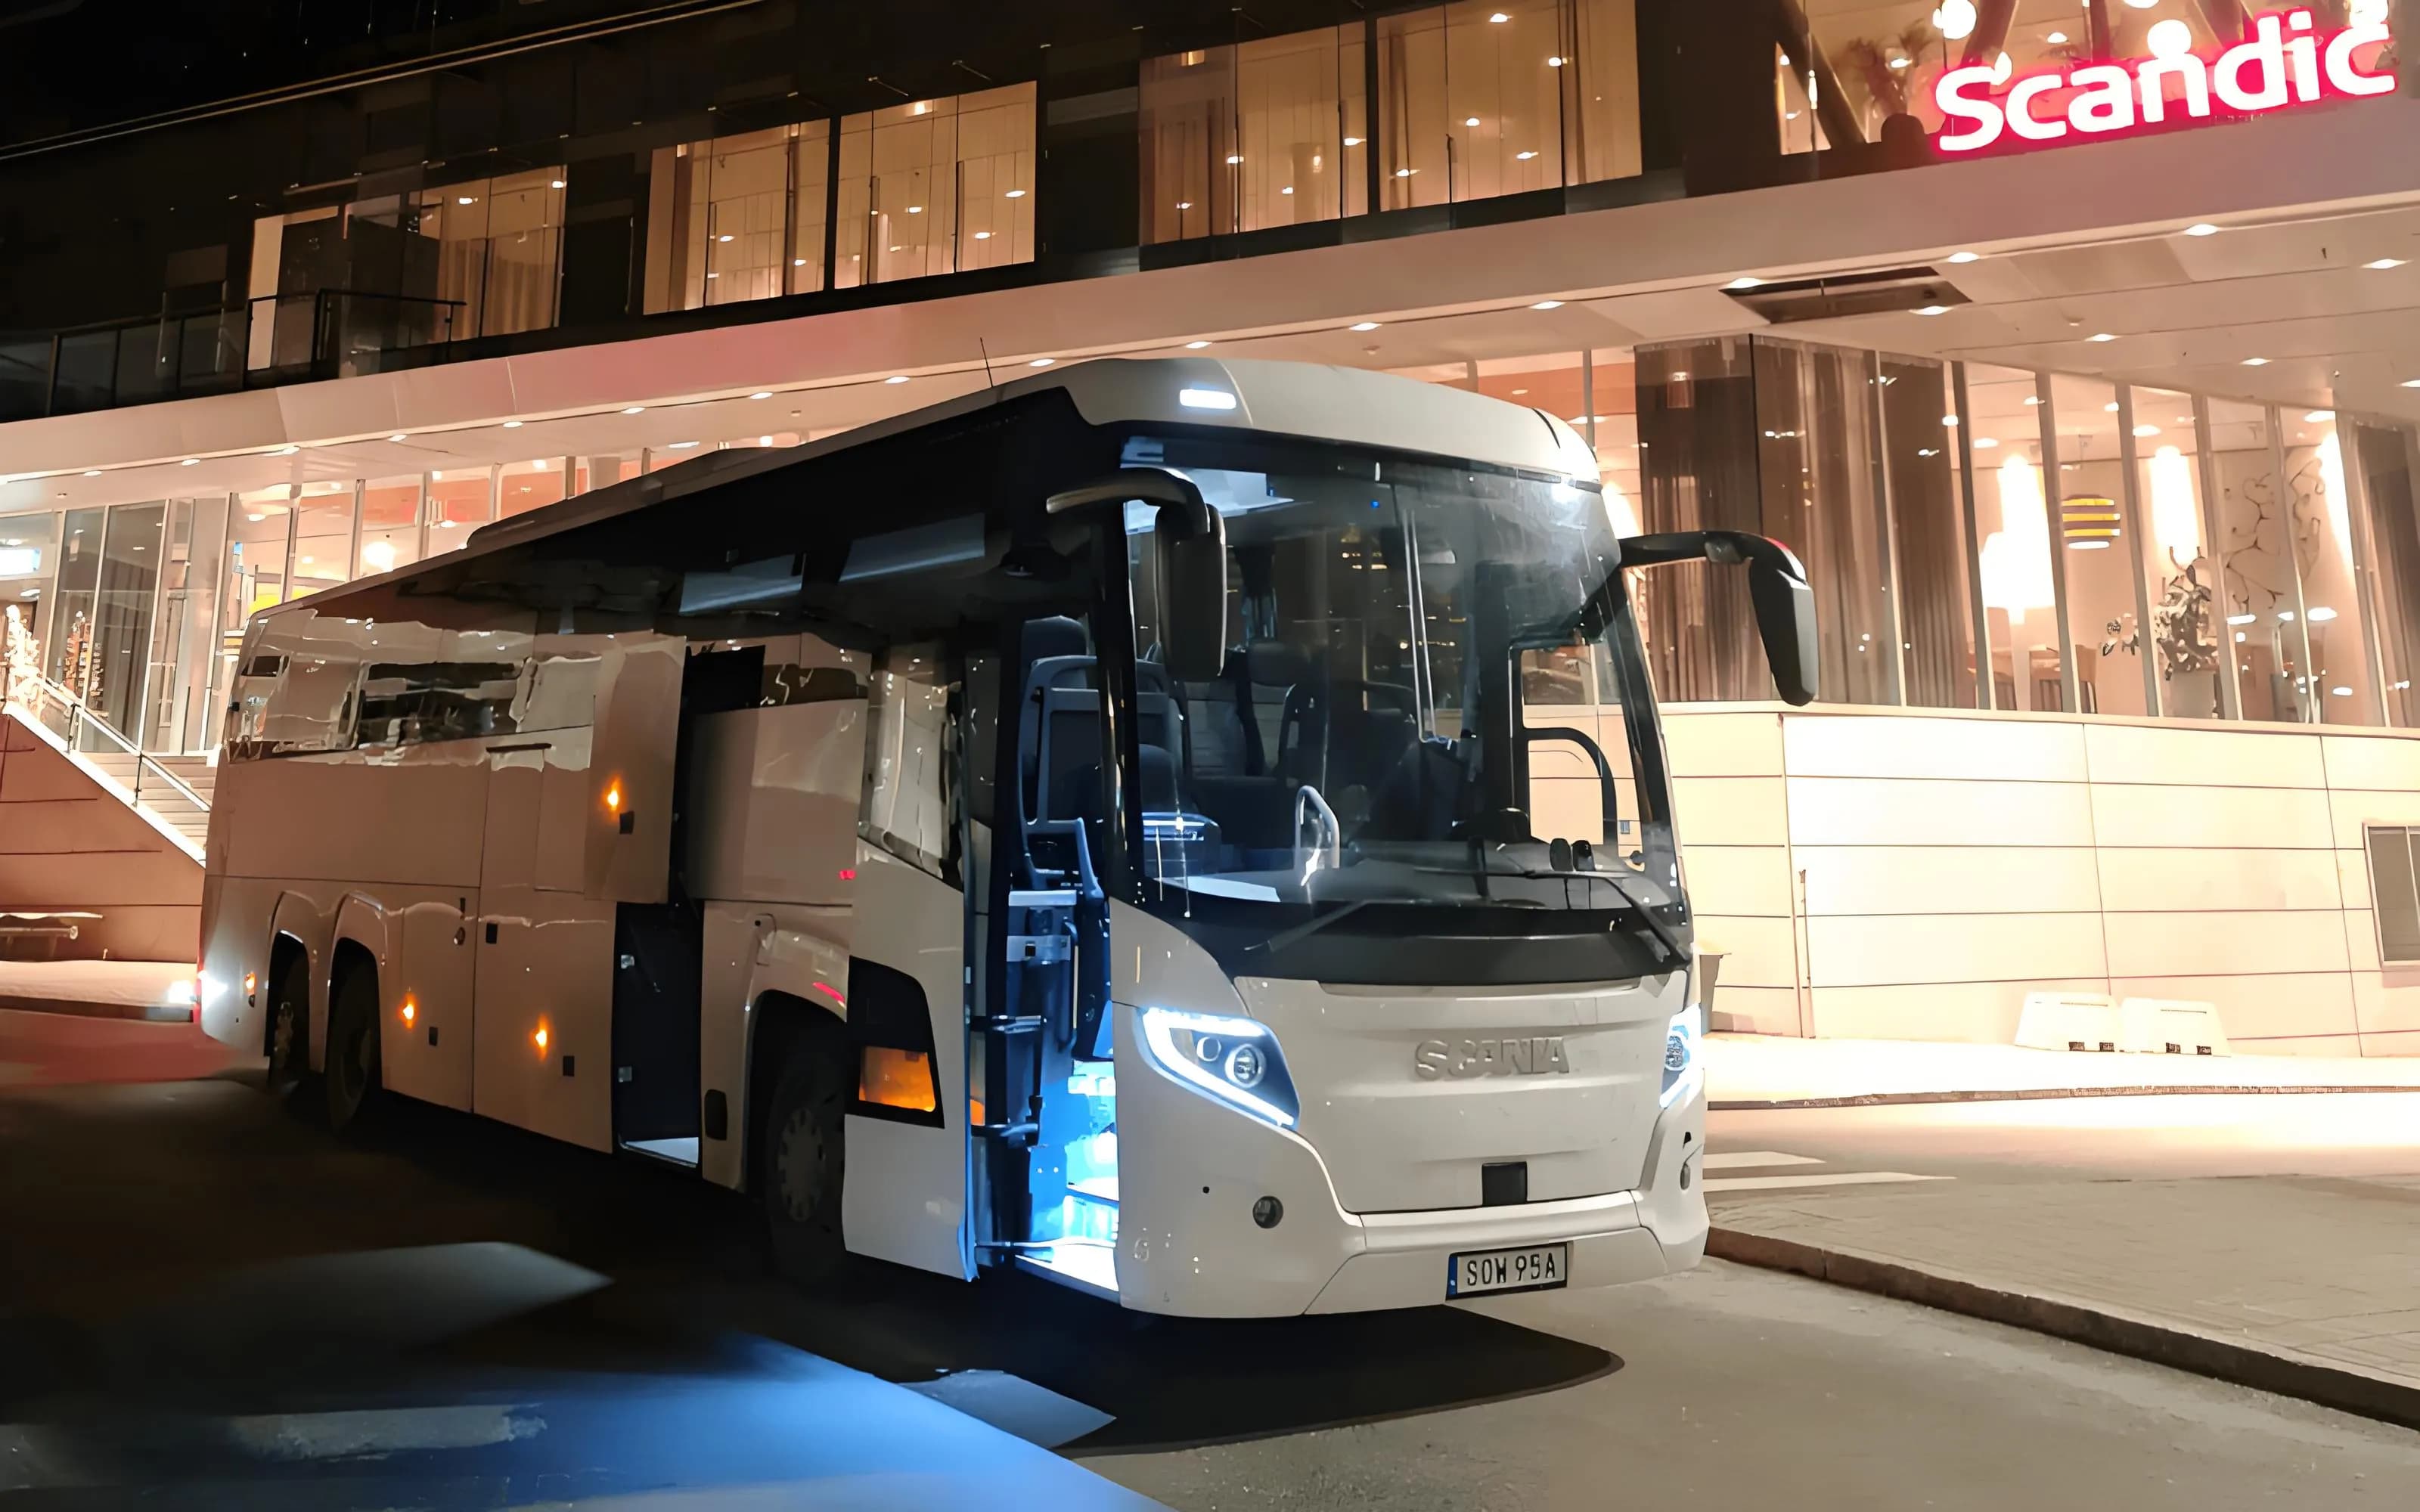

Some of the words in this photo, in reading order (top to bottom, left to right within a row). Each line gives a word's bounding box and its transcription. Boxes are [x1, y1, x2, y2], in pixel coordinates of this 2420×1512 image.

[1934, 11, 2396, 152] Scandic
[1415, 1036, 1570, 1080] SCANIA
[1467, 1256, 1507, 1286] SOW
[1515, 1252, 1556, 1281] 95A
